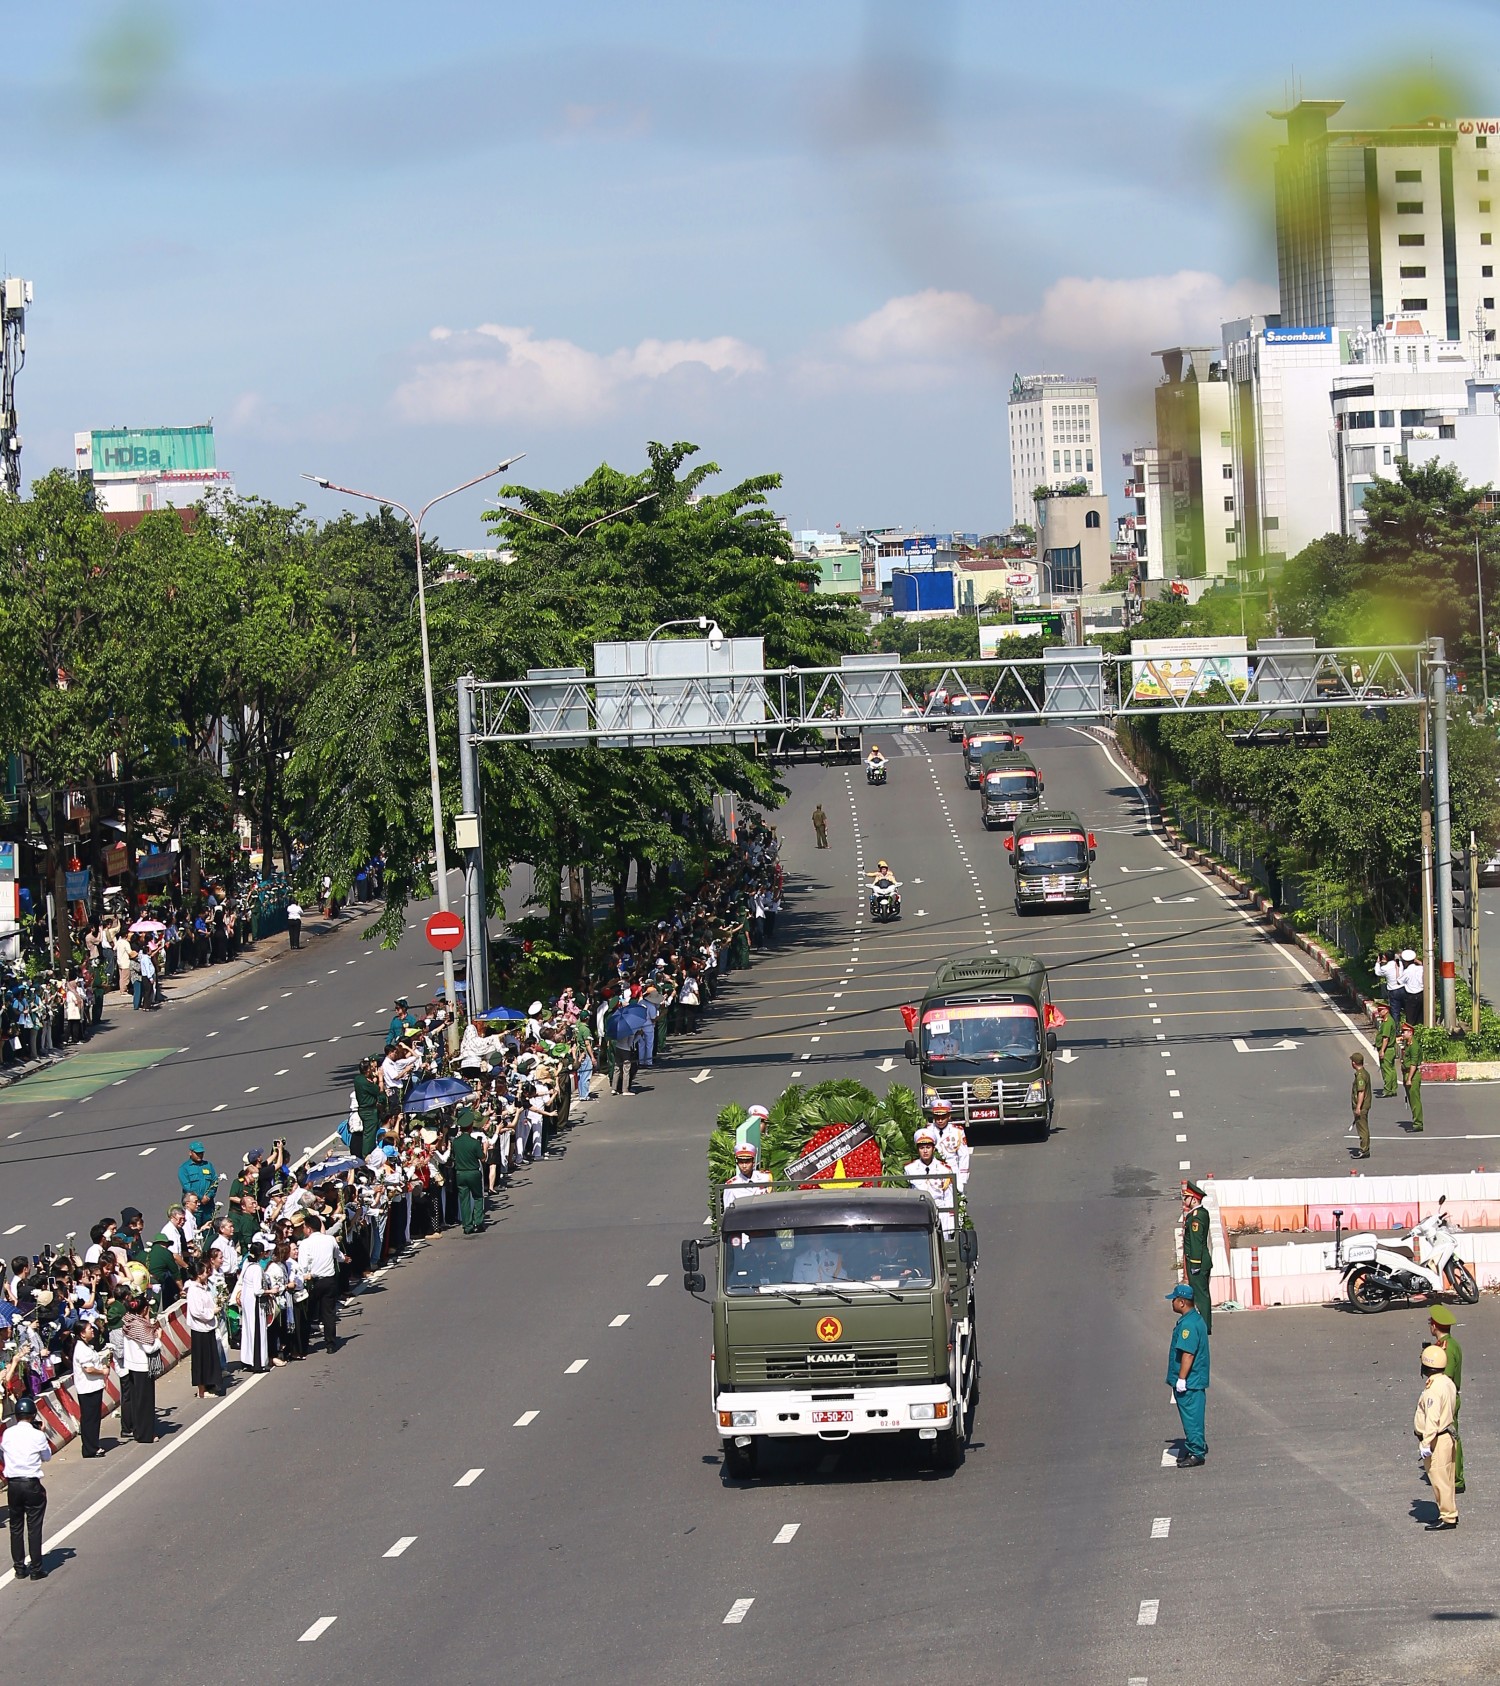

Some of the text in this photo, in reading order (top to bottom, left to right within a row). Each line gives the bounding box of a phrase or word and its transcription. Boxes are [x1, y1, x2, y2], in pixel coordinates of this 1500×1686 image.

[1476, 122, 1500, 134] Wel
[1266, 331, 1326, 342] Sacombank
[807, 1353, 856, 1363] KAMAZ
[813, 1411, 853, 1422] KP-50-20
